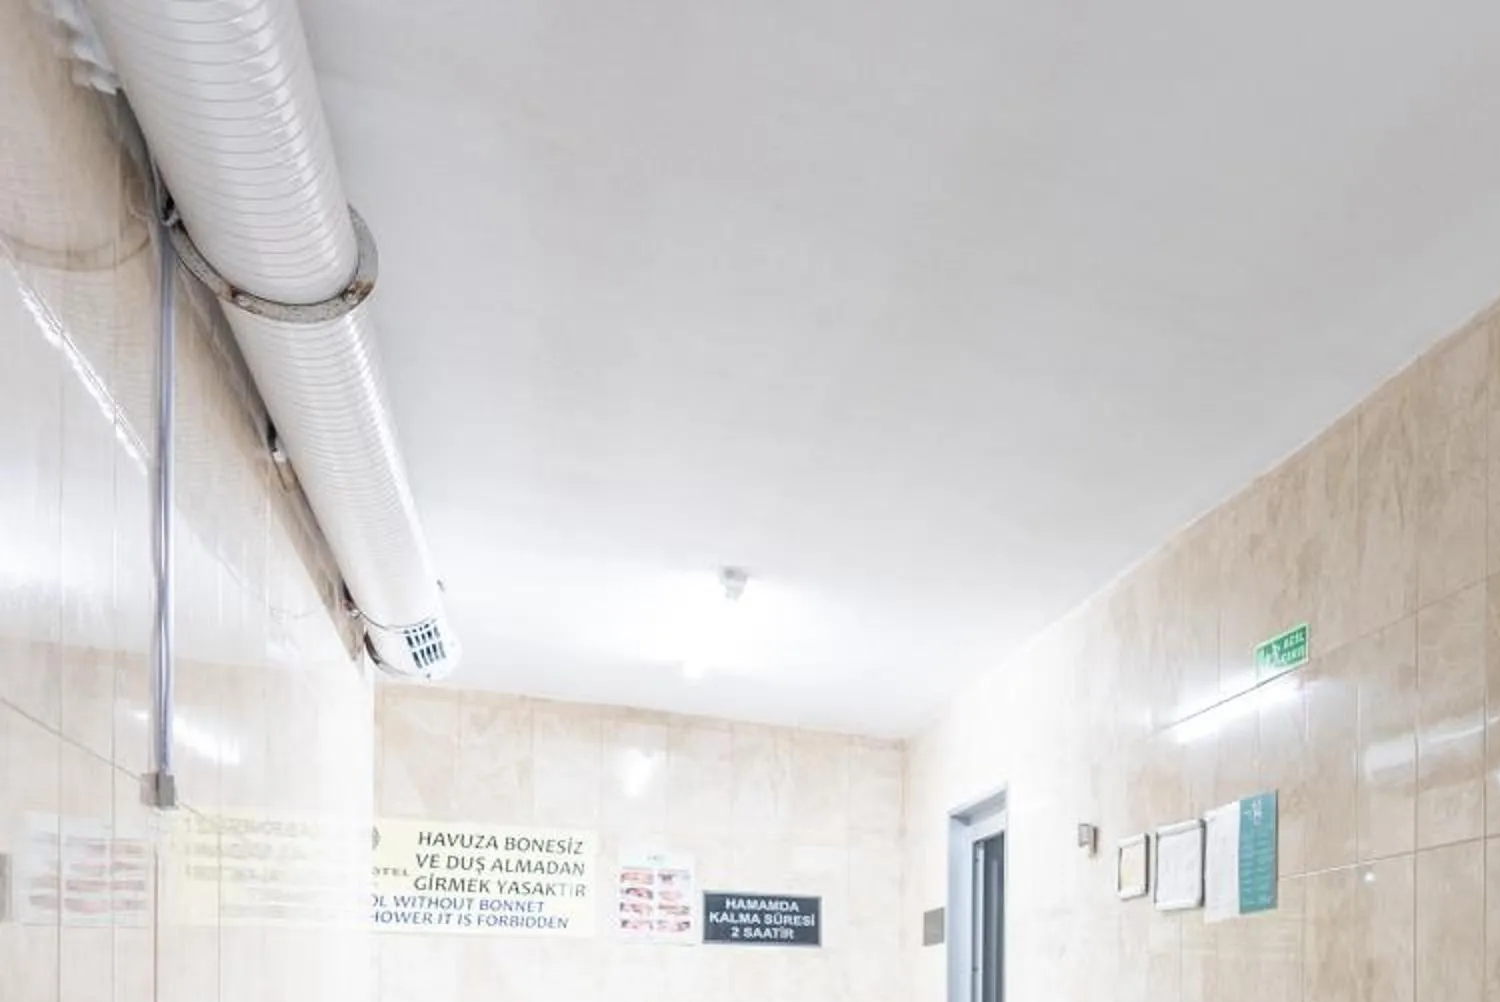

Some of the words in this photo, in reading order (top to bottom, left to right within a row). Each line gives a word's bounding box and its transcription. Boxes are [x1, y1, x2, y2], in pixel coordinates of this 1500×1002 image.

[721, 690, 853, 752] HAMAM
[418, 831, 498, 850] HAVUZA
[504, 836, 584, 855] BONESİZ
[415, 853, 441, 869] VE
[447, 855, 486, 876] DUŞ
[491, 857, 585, 877] ALMADAN
[413, 872, 491, 893] GİRMEK
[498, 879, 587, 897] YASAKTIR
[393, 895, 474, 911] WITHOUT
[479, 899, 545, 913] BONNET
[725, 897, 799, 912] HAMAMDA
[437, 911, 454, 925] IT
[457, 913, 473, 927] IS
[477, 914, 570, 929] FORBIDDEN
[709, 911, 760, 924] KALMA
[731, 926, 740, 938] 2
